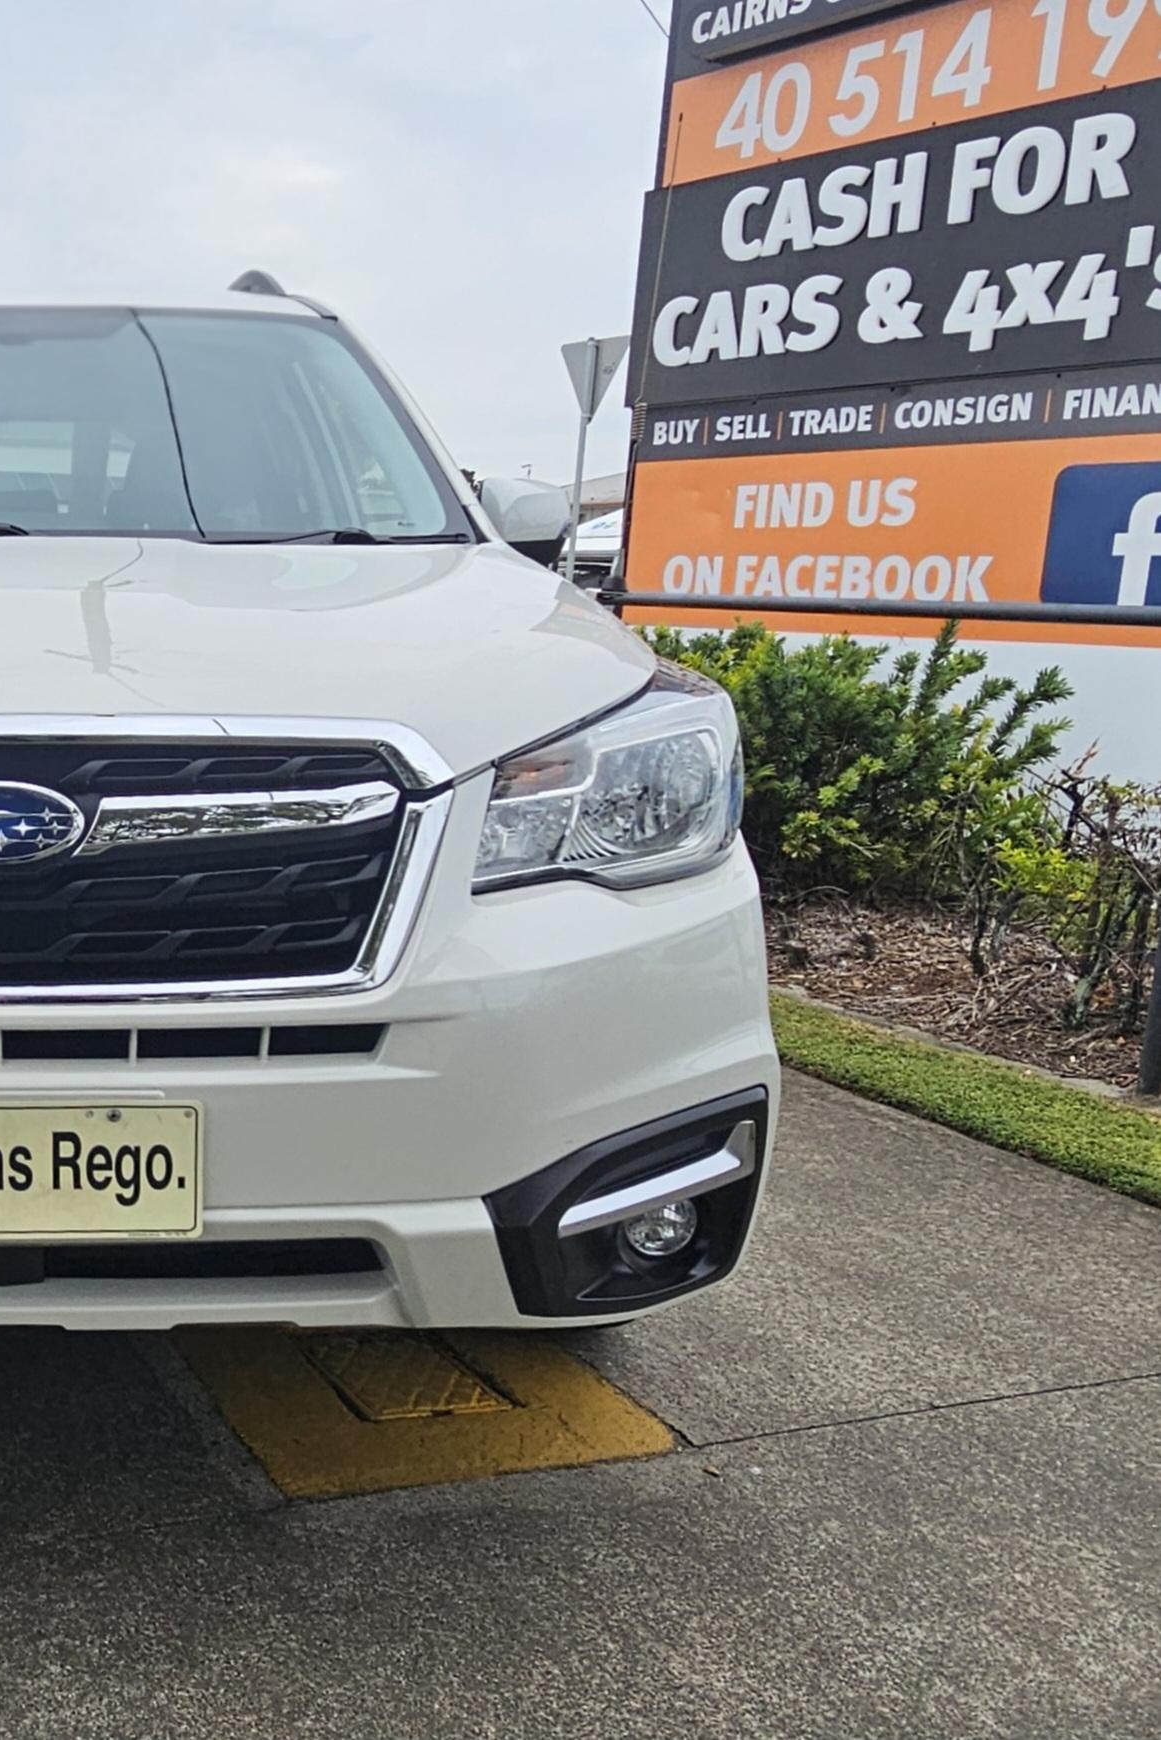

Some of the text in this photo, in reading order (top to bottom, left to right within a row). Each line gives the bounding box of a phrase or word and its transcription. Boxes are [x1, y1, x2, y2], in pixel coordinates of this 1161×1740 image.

[714, 0, 1161, 159] 40 514 19
[721, 112, 1137, 262] CASH FOR
[652, 274, 844, 368] CARS
[856, 267, 924, 344] &
[652, 418, 700, 446] BUY
[714, 413, 772, 442] SELL
[789, 404, 874, 436] TRADE
[894, 392, 1033, 430] CONSIGN
[733, 477, 918, 529] FIND US
[663, 554, 994, 603] ON FACEBOOK
[52, 1131, 187, 1207] Rego.
